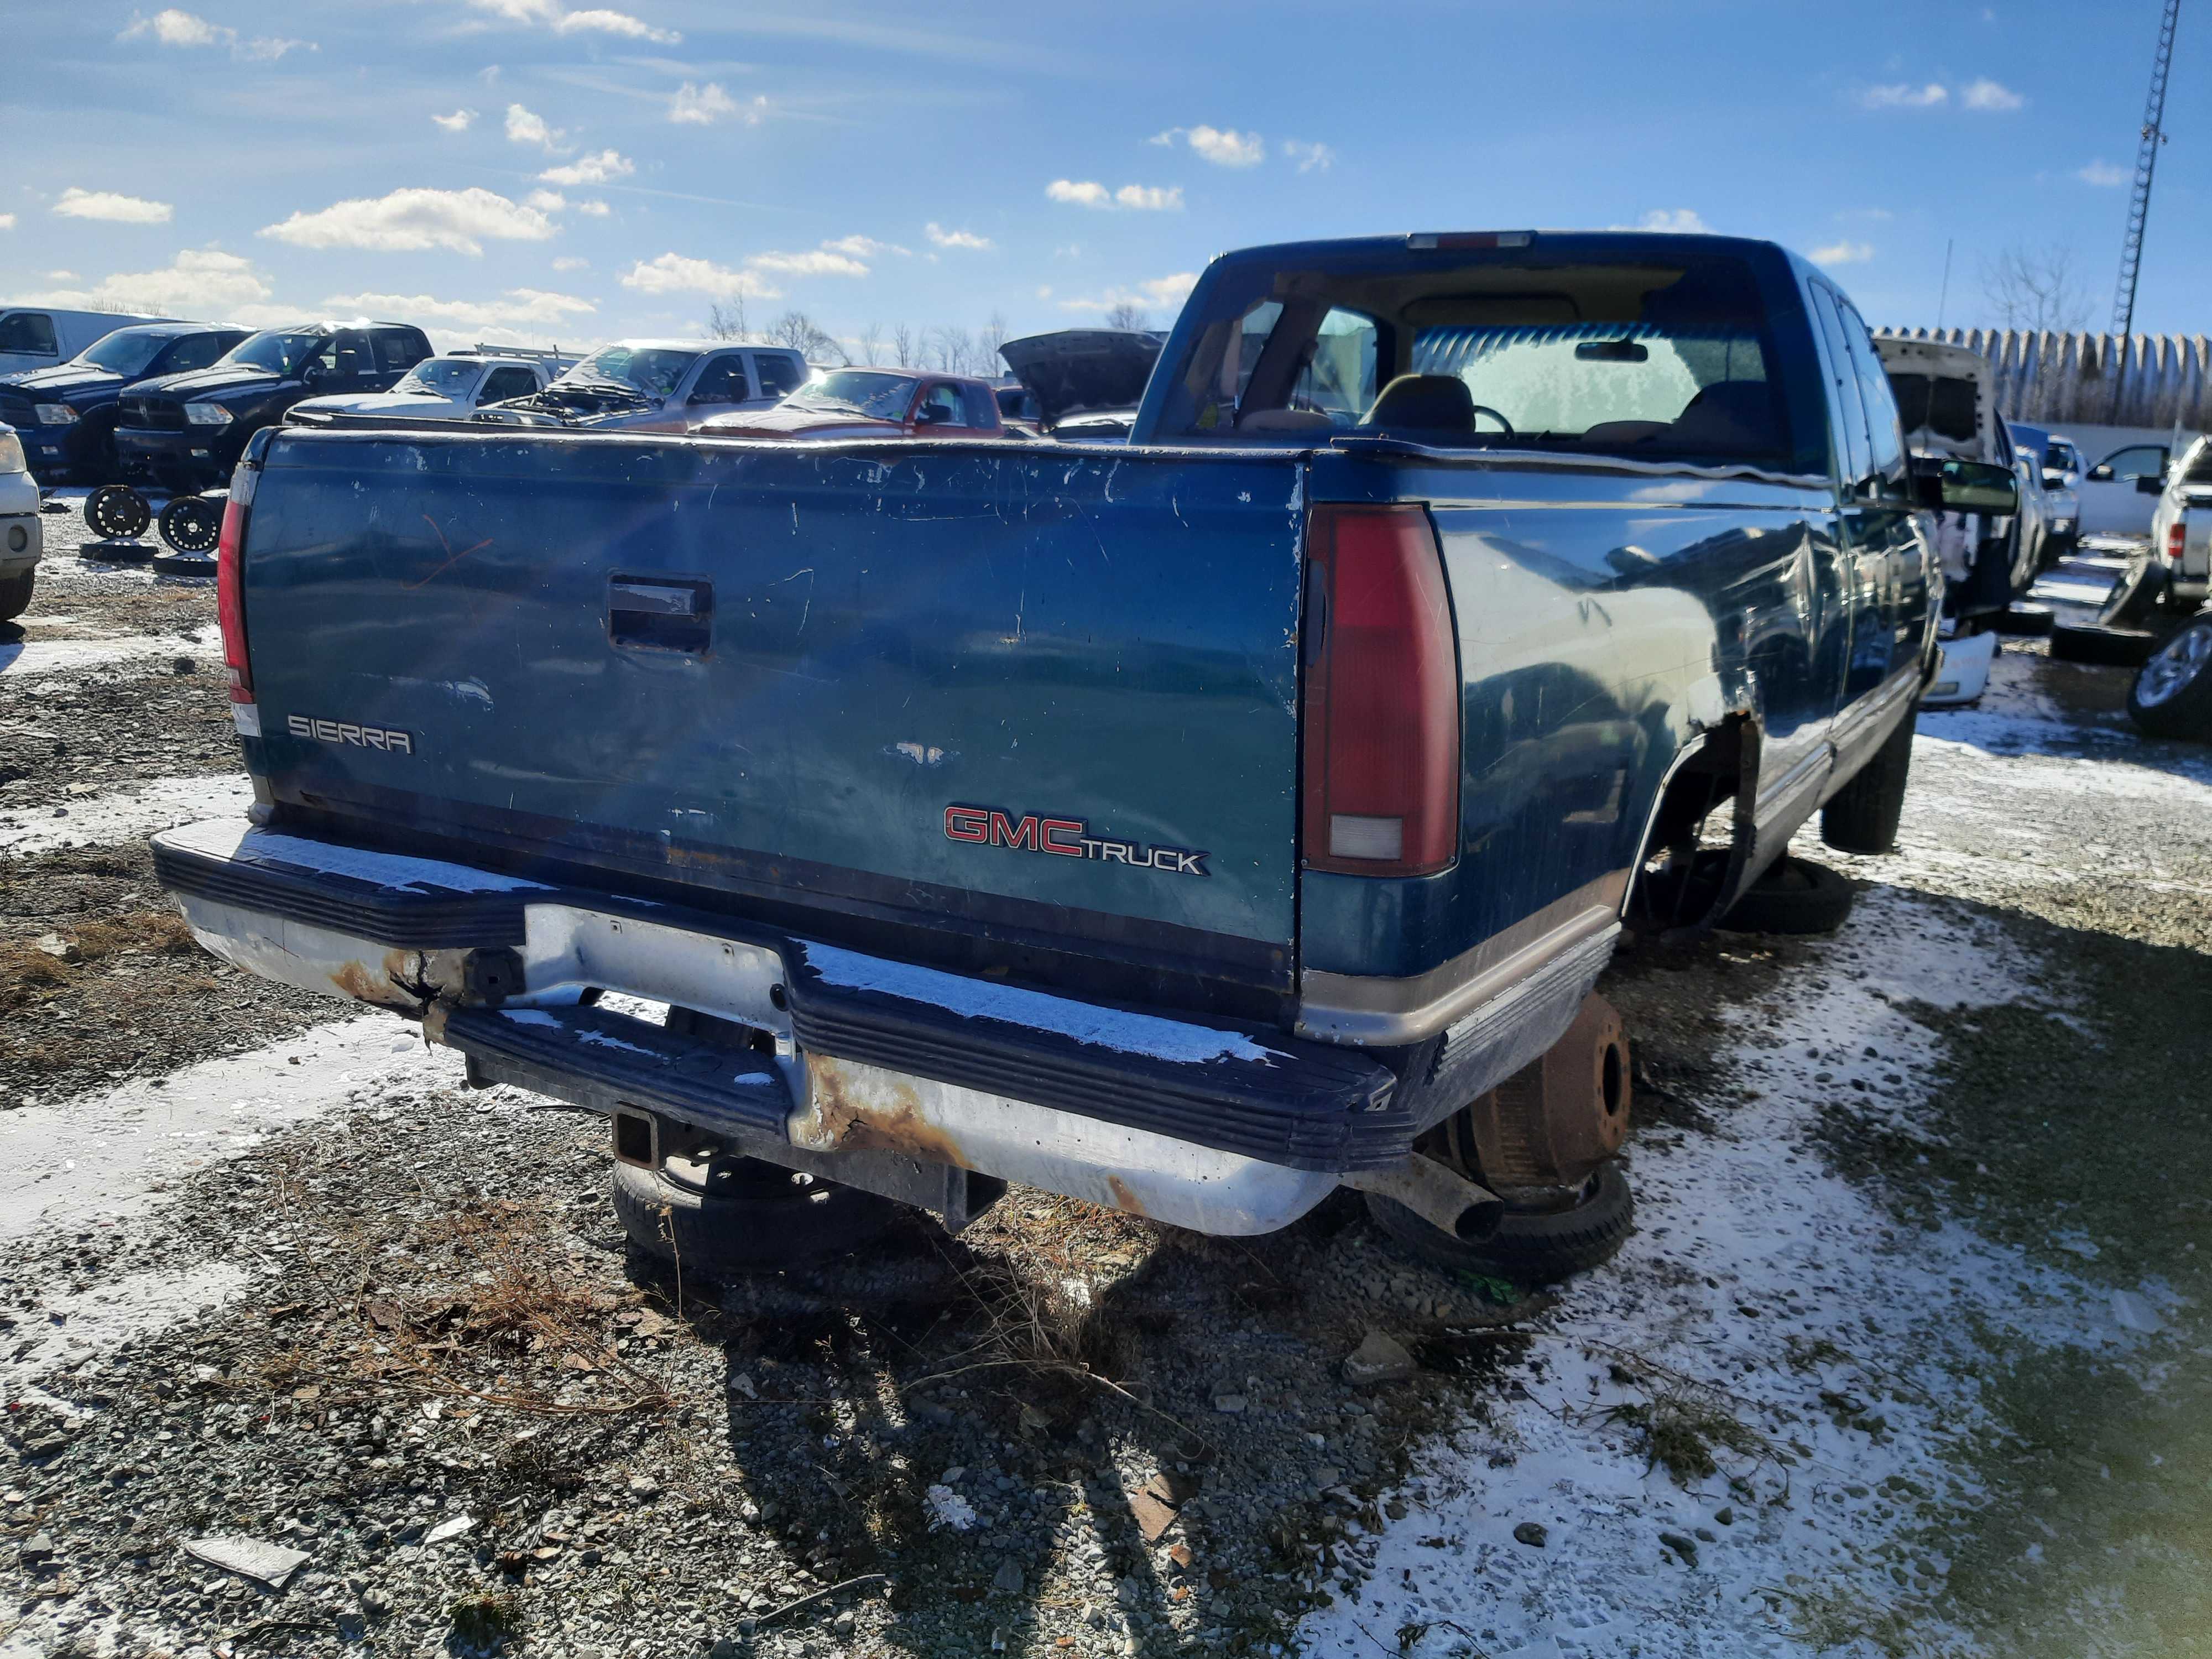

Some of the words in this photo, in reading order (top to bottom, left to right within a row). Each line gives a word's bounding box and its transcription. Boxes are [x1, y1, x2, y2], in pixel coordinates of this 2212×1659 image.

[287, 714, 411, 755] SIERRA
[944, 806, 1083, 857] GMC
[1080, 838, 1209, 876] TRUCK
